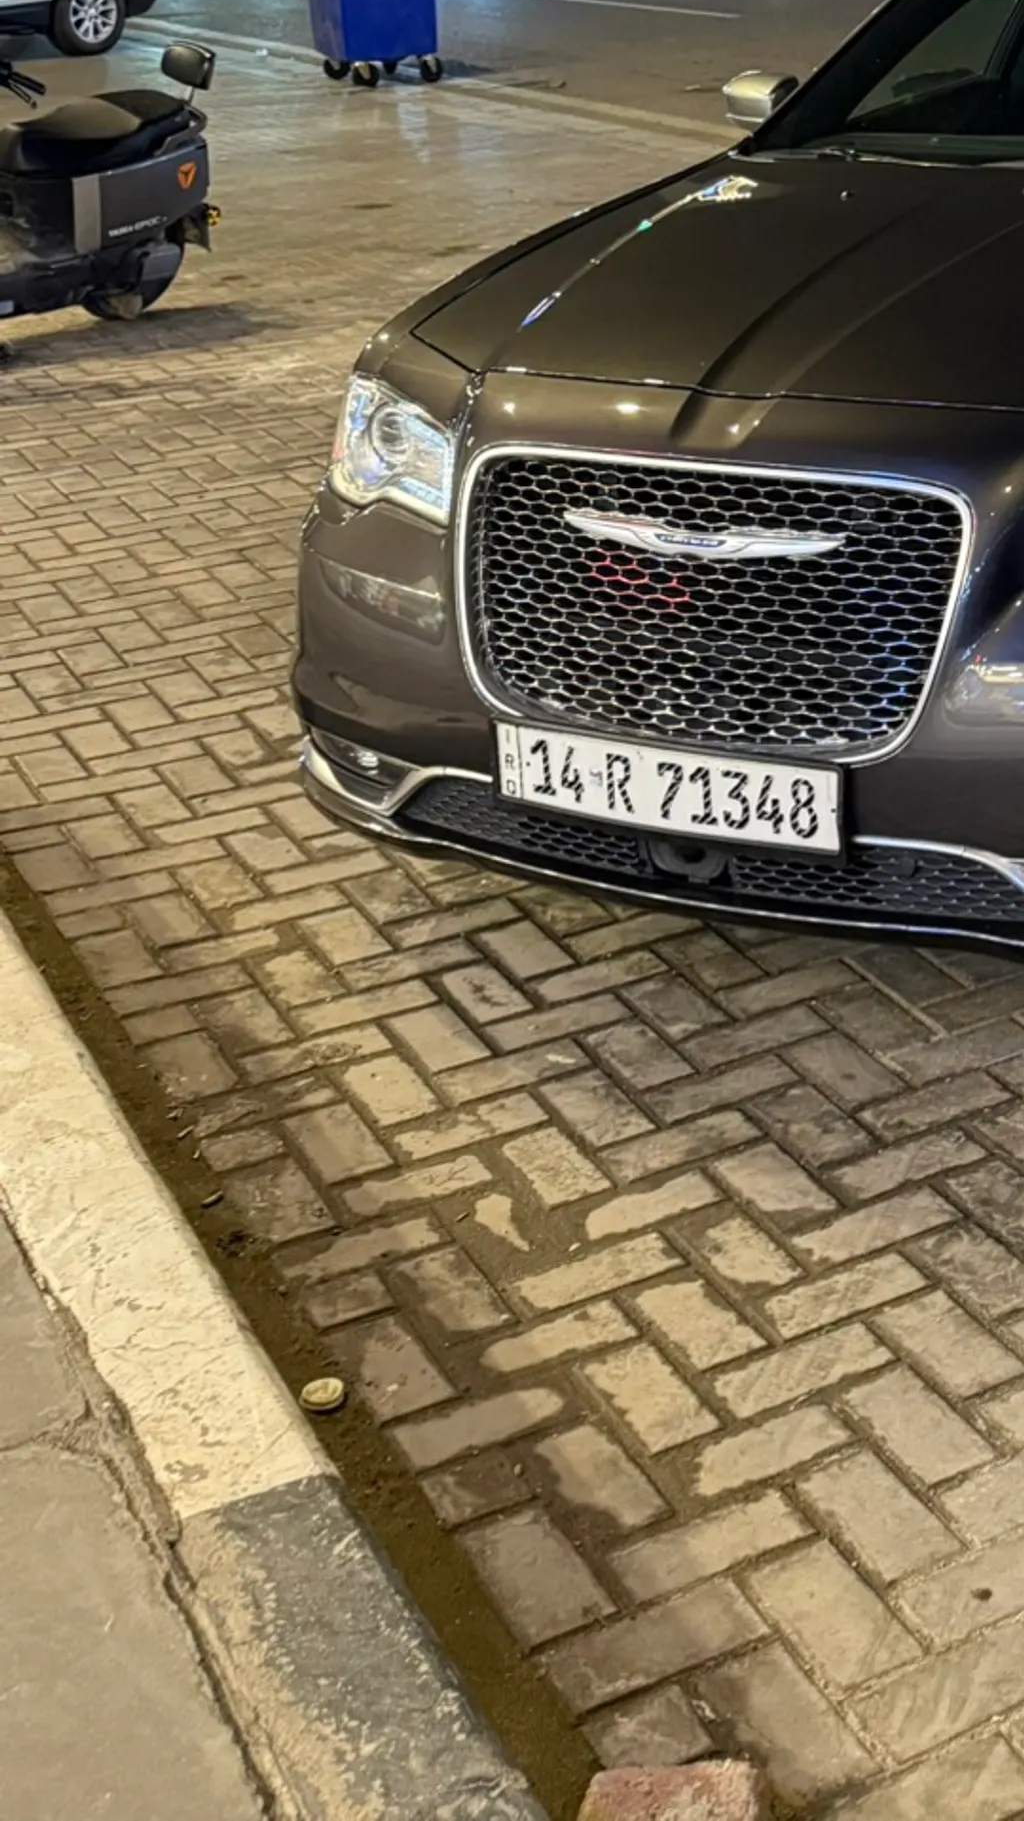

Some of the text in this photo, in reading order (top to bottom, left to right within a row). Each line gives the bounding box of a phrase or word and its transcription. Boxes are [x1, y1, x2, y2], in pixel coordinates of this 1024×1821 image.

[530, 738, 819, 839] 14 R 71348
